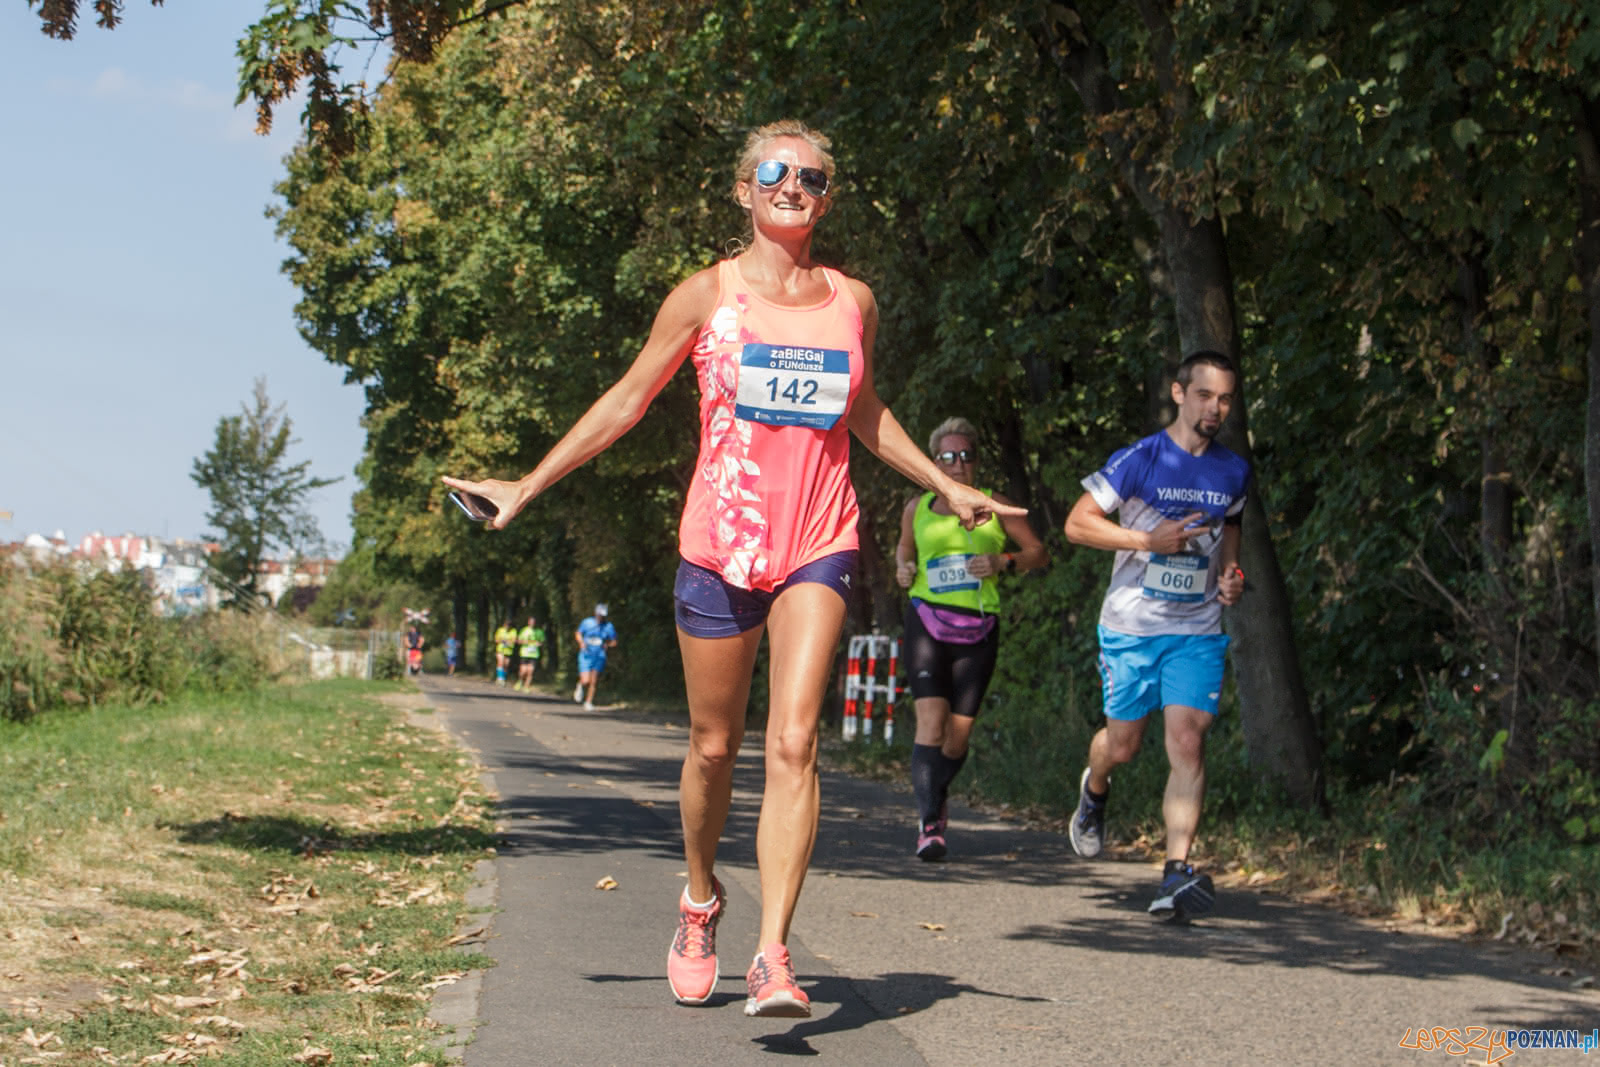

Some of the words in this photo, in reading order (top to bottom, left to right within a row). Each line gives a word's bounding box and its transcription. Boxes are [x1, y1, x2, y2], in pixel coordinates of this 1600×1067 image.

[770, 348, 824, 364] zaBIEGaj
[778, 360, 824, 371] FUNdusze
[766, 376, 819, 405] 142
[1157, 487, 1204, 504] YANOSIK
[939, 567, 966, 582] 039
[1161, 571, 1193, 590] 060
